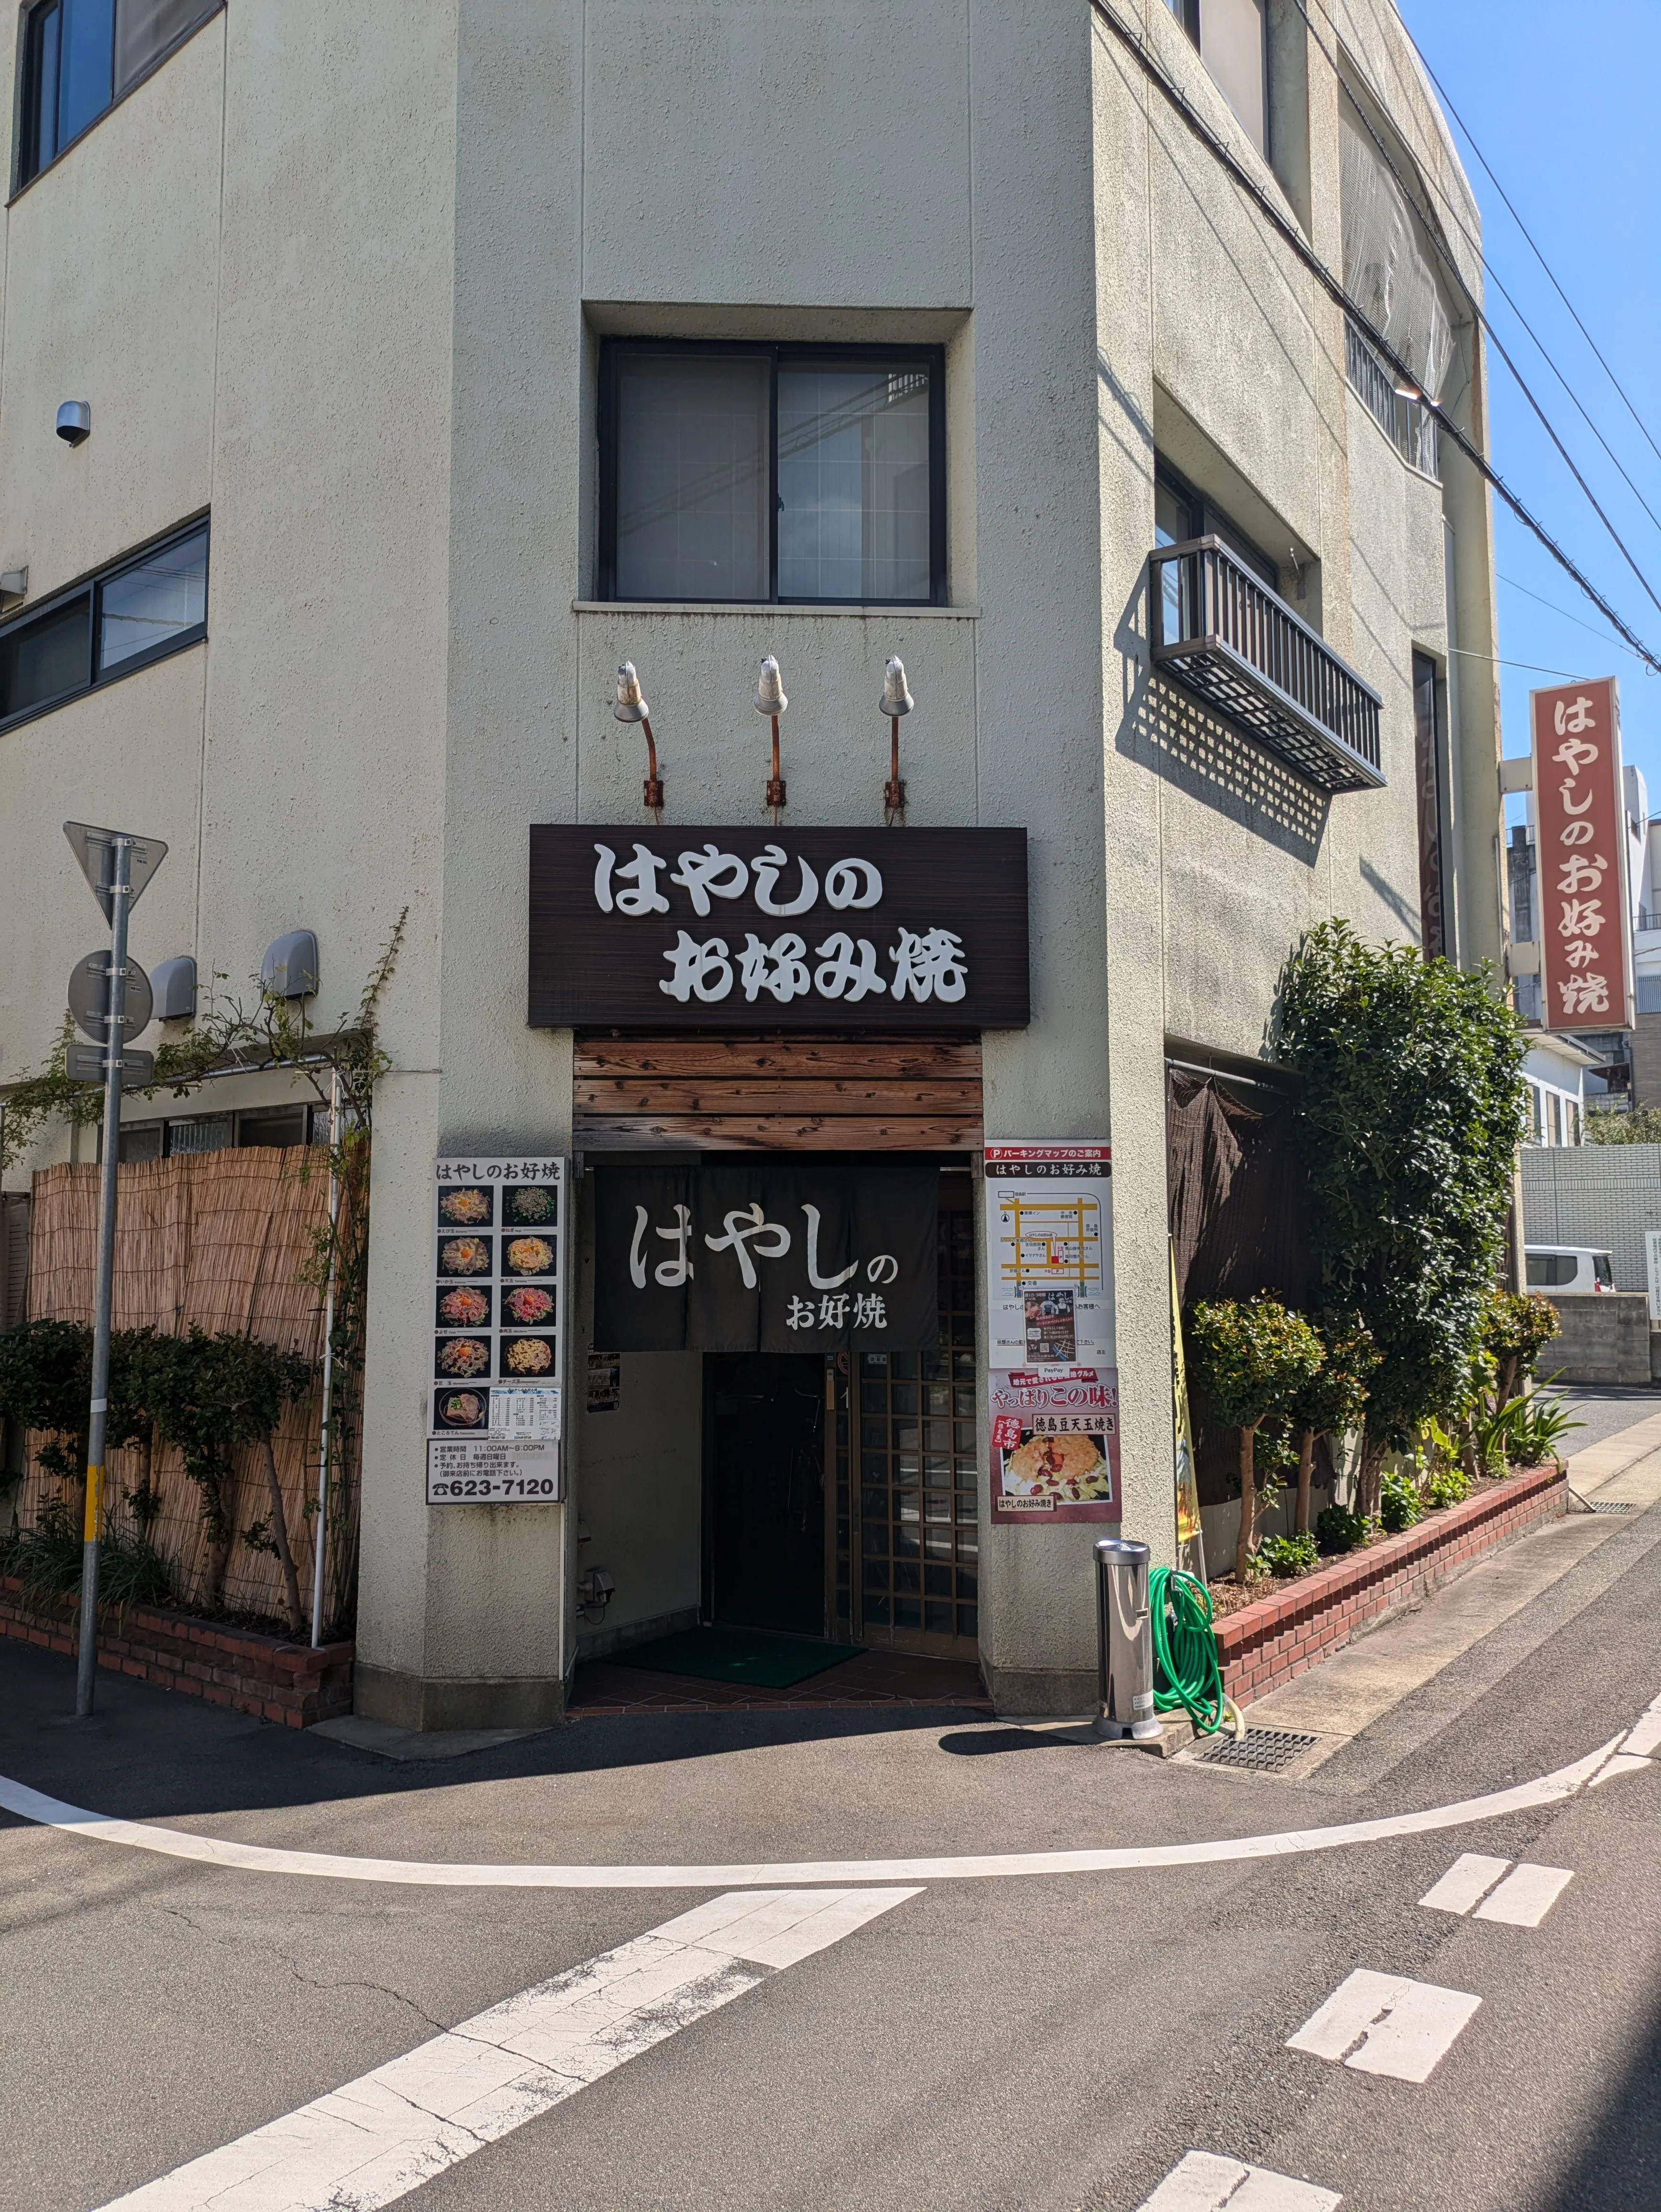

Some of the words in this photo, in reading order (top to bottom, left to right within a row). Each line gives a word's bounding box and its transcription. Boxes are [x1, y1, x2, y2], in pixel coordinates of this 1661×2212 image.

[1552, 697, 1608, 1014] はやしのお好み焼
[594, 843, 883, 917] はやしの
[659, 927, 968, 1003] お好み焼
[1004, 1149, 1101, 1158] パーキングマップのご案内
[436, 1161, 560, 1181] はやしのお好焼
[996, 1163, 1102, 1175] はやしのお好み焼
[630, 1203, 898, 1289] はやしの
[786, 1293, 887, 1330] お好焼
[991, 1384, 1118, 1408] やっぱりこの味!
[1003, 1418, 1020, 1449] 徳島市
[1035, 1417, 1114, 1431] 徳島豆天玉焼き
[450, 1479, 554, 1496] 623-7120
[999, 1500, 1052, 1508] はやしのお好み焼き
